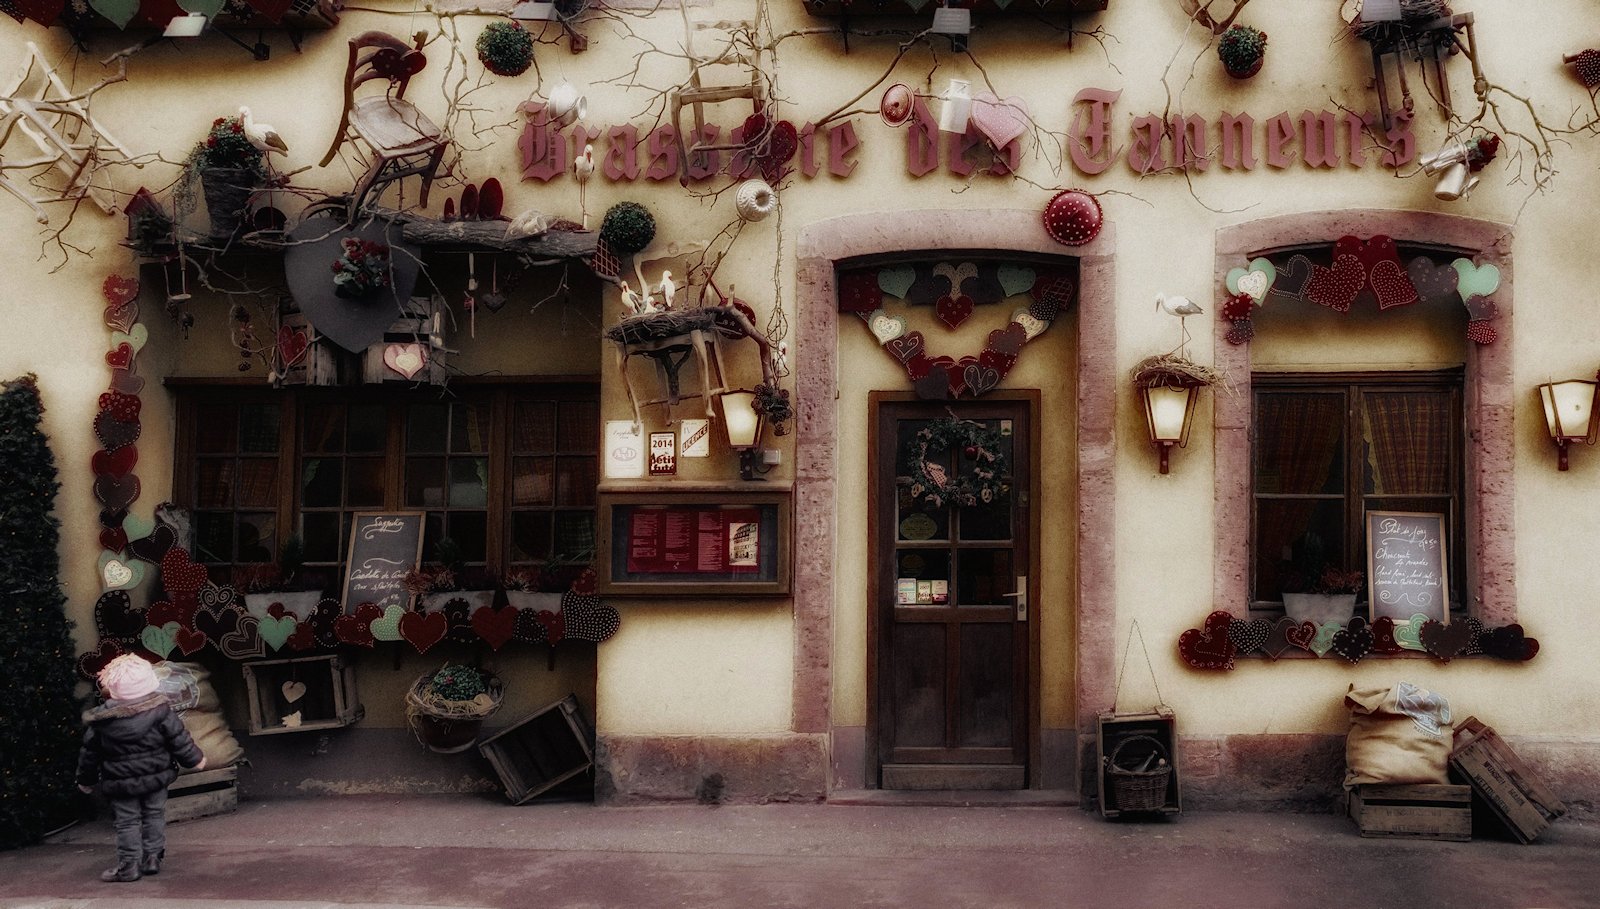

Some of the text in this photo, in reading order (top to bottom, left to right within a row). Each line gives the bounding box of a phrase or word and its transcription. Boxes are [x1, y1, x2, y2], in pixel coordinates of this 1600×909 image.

[515, 100, 858, 182] Brasseie
[1069, 87, 1417, 175] Tanneurs
[652, 440, 673, 448] 2014
